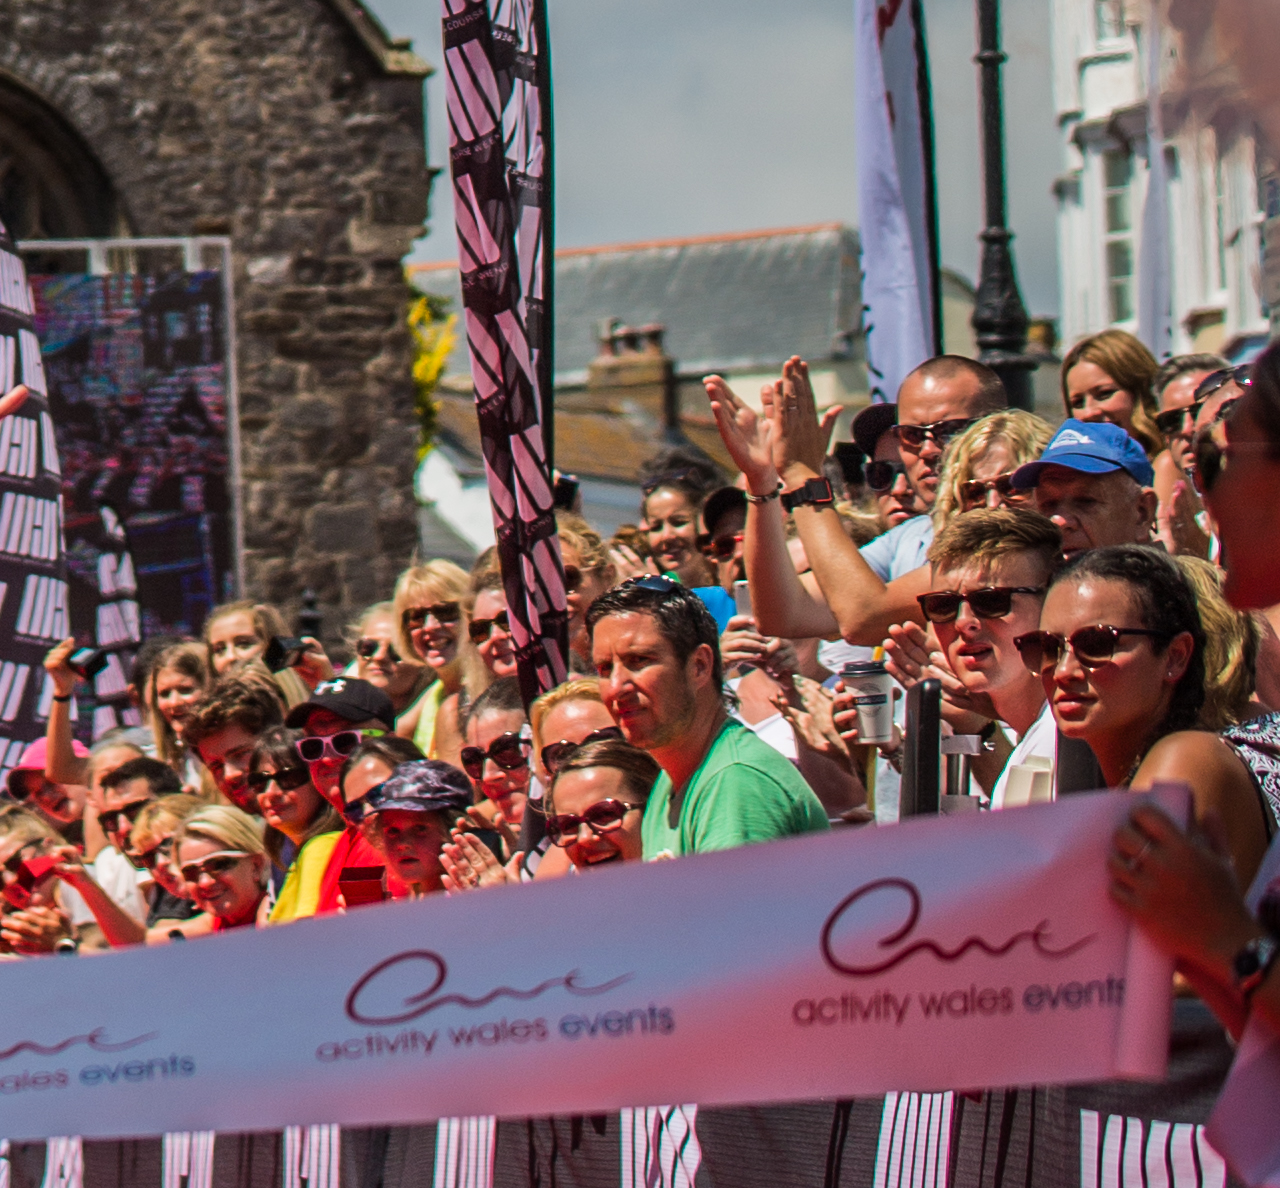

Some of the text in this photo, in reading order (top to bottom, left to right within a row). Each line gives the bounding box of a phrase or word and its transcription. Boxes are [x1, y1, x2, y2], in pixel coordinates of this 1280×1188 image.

[792, 988, 910, 1027] activity
[919, 983, 1015, 1018] wales
[315, 1001, 676, 1063] activity wales events
[79, 1053, 197, 1087] events
